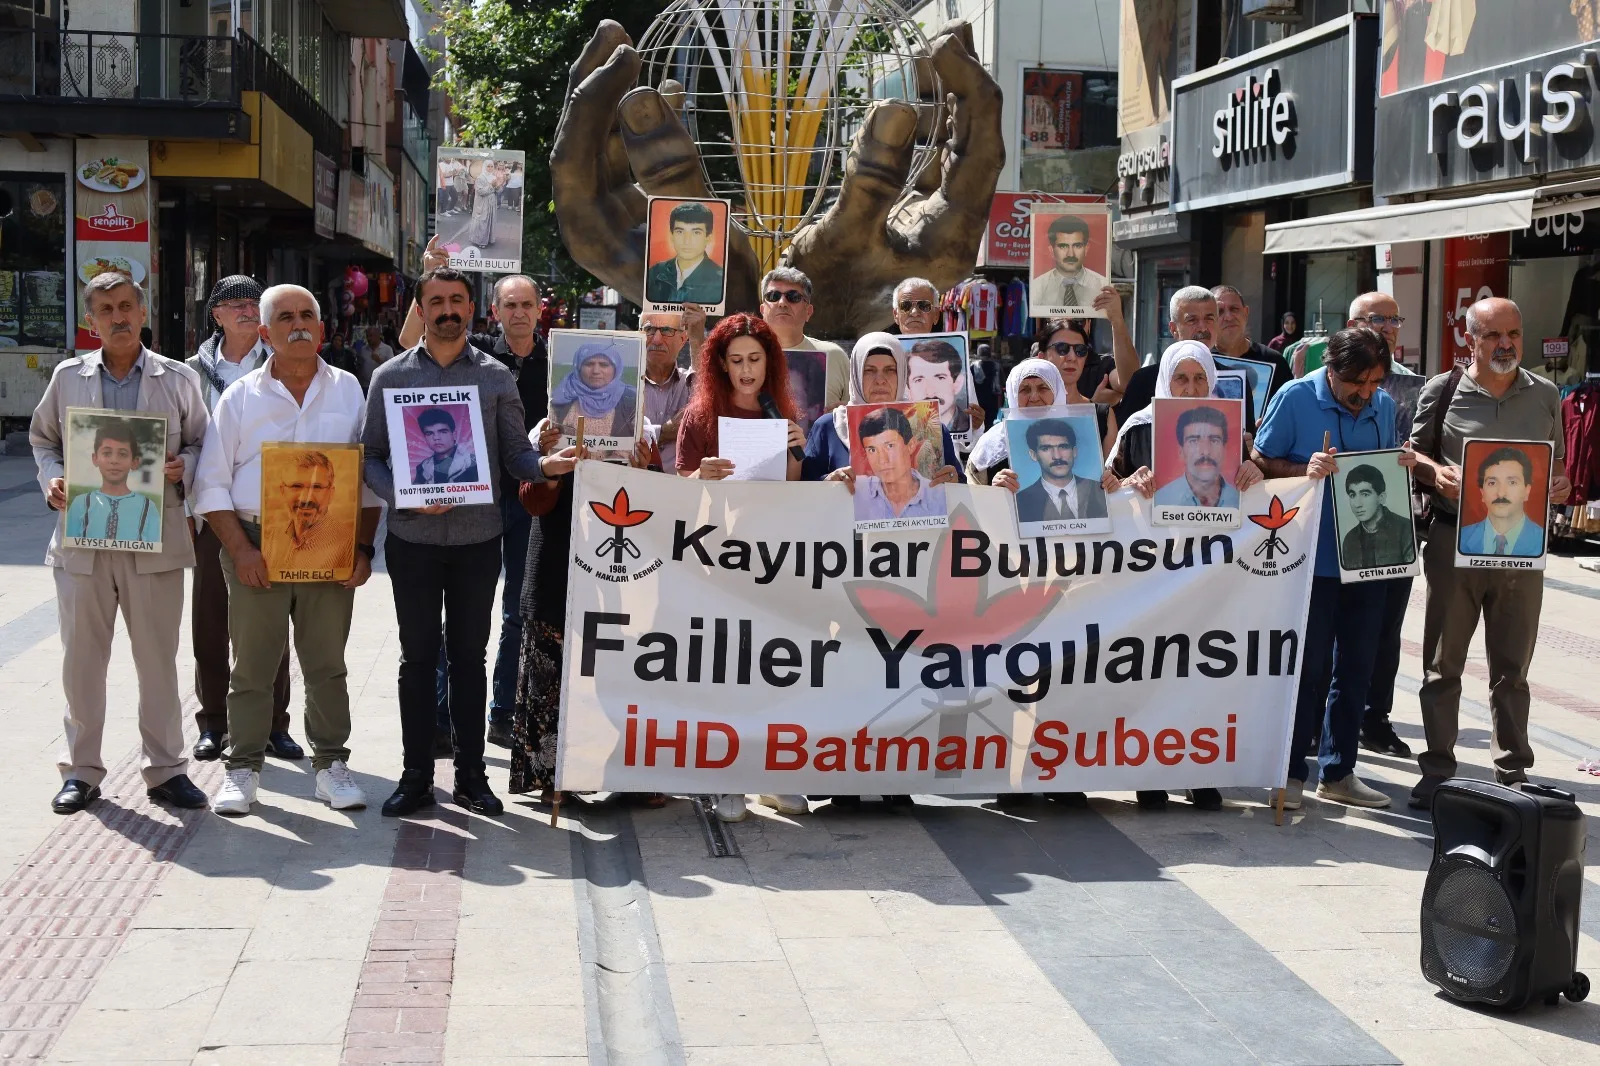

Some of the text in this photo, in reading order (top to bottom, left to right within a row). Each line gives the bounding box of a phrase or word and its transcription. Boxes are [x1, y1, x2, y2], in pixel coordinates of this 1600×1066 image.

[1212, 68, 1291, 158] stilife
[94, 216, 129, 228] şenpiliç
[447, 258, 516, 269] ERYEM BULUT
[652, 304, 686, 313] M.ŞİRİN
[1545, 343, 1561, 353] 199
[394, 390, 472, 404] EDİP ÇELİK
[599, 438, 618, 447] Ana
[446, 484, 490, 493] GÖZALTINDA
[1162, 509, 1233, 523] Eset GÖKTAYI
[856, 517, 947, 530] MEHMET ZEKİ AKYILDIZ
[74, 537, 154, 551] VEYSEL ATILGAN
[671, 519, 1234, 590] Kayıplar Bulunsun
[609, 564, 627, 574] 1986
[1262, 561, 1277, 569] 1986
[1470, 558, 1533, 568] İZZET SEVEN
[279, 568, 334, 580] TAHİR ELÇİ
[595, 570, 629, 583] HAKLARI
[632, 557, 664, 581] DERNEĞİ
[1251, 567, 1279, 577] HAKLARI
[1359, 566, 1408, 579] ÇETİN ABAY
[581, 611, 1299, 704] Failler Yargılansın
[624, 704, 1237, 780] İHD Batman Şubesi
